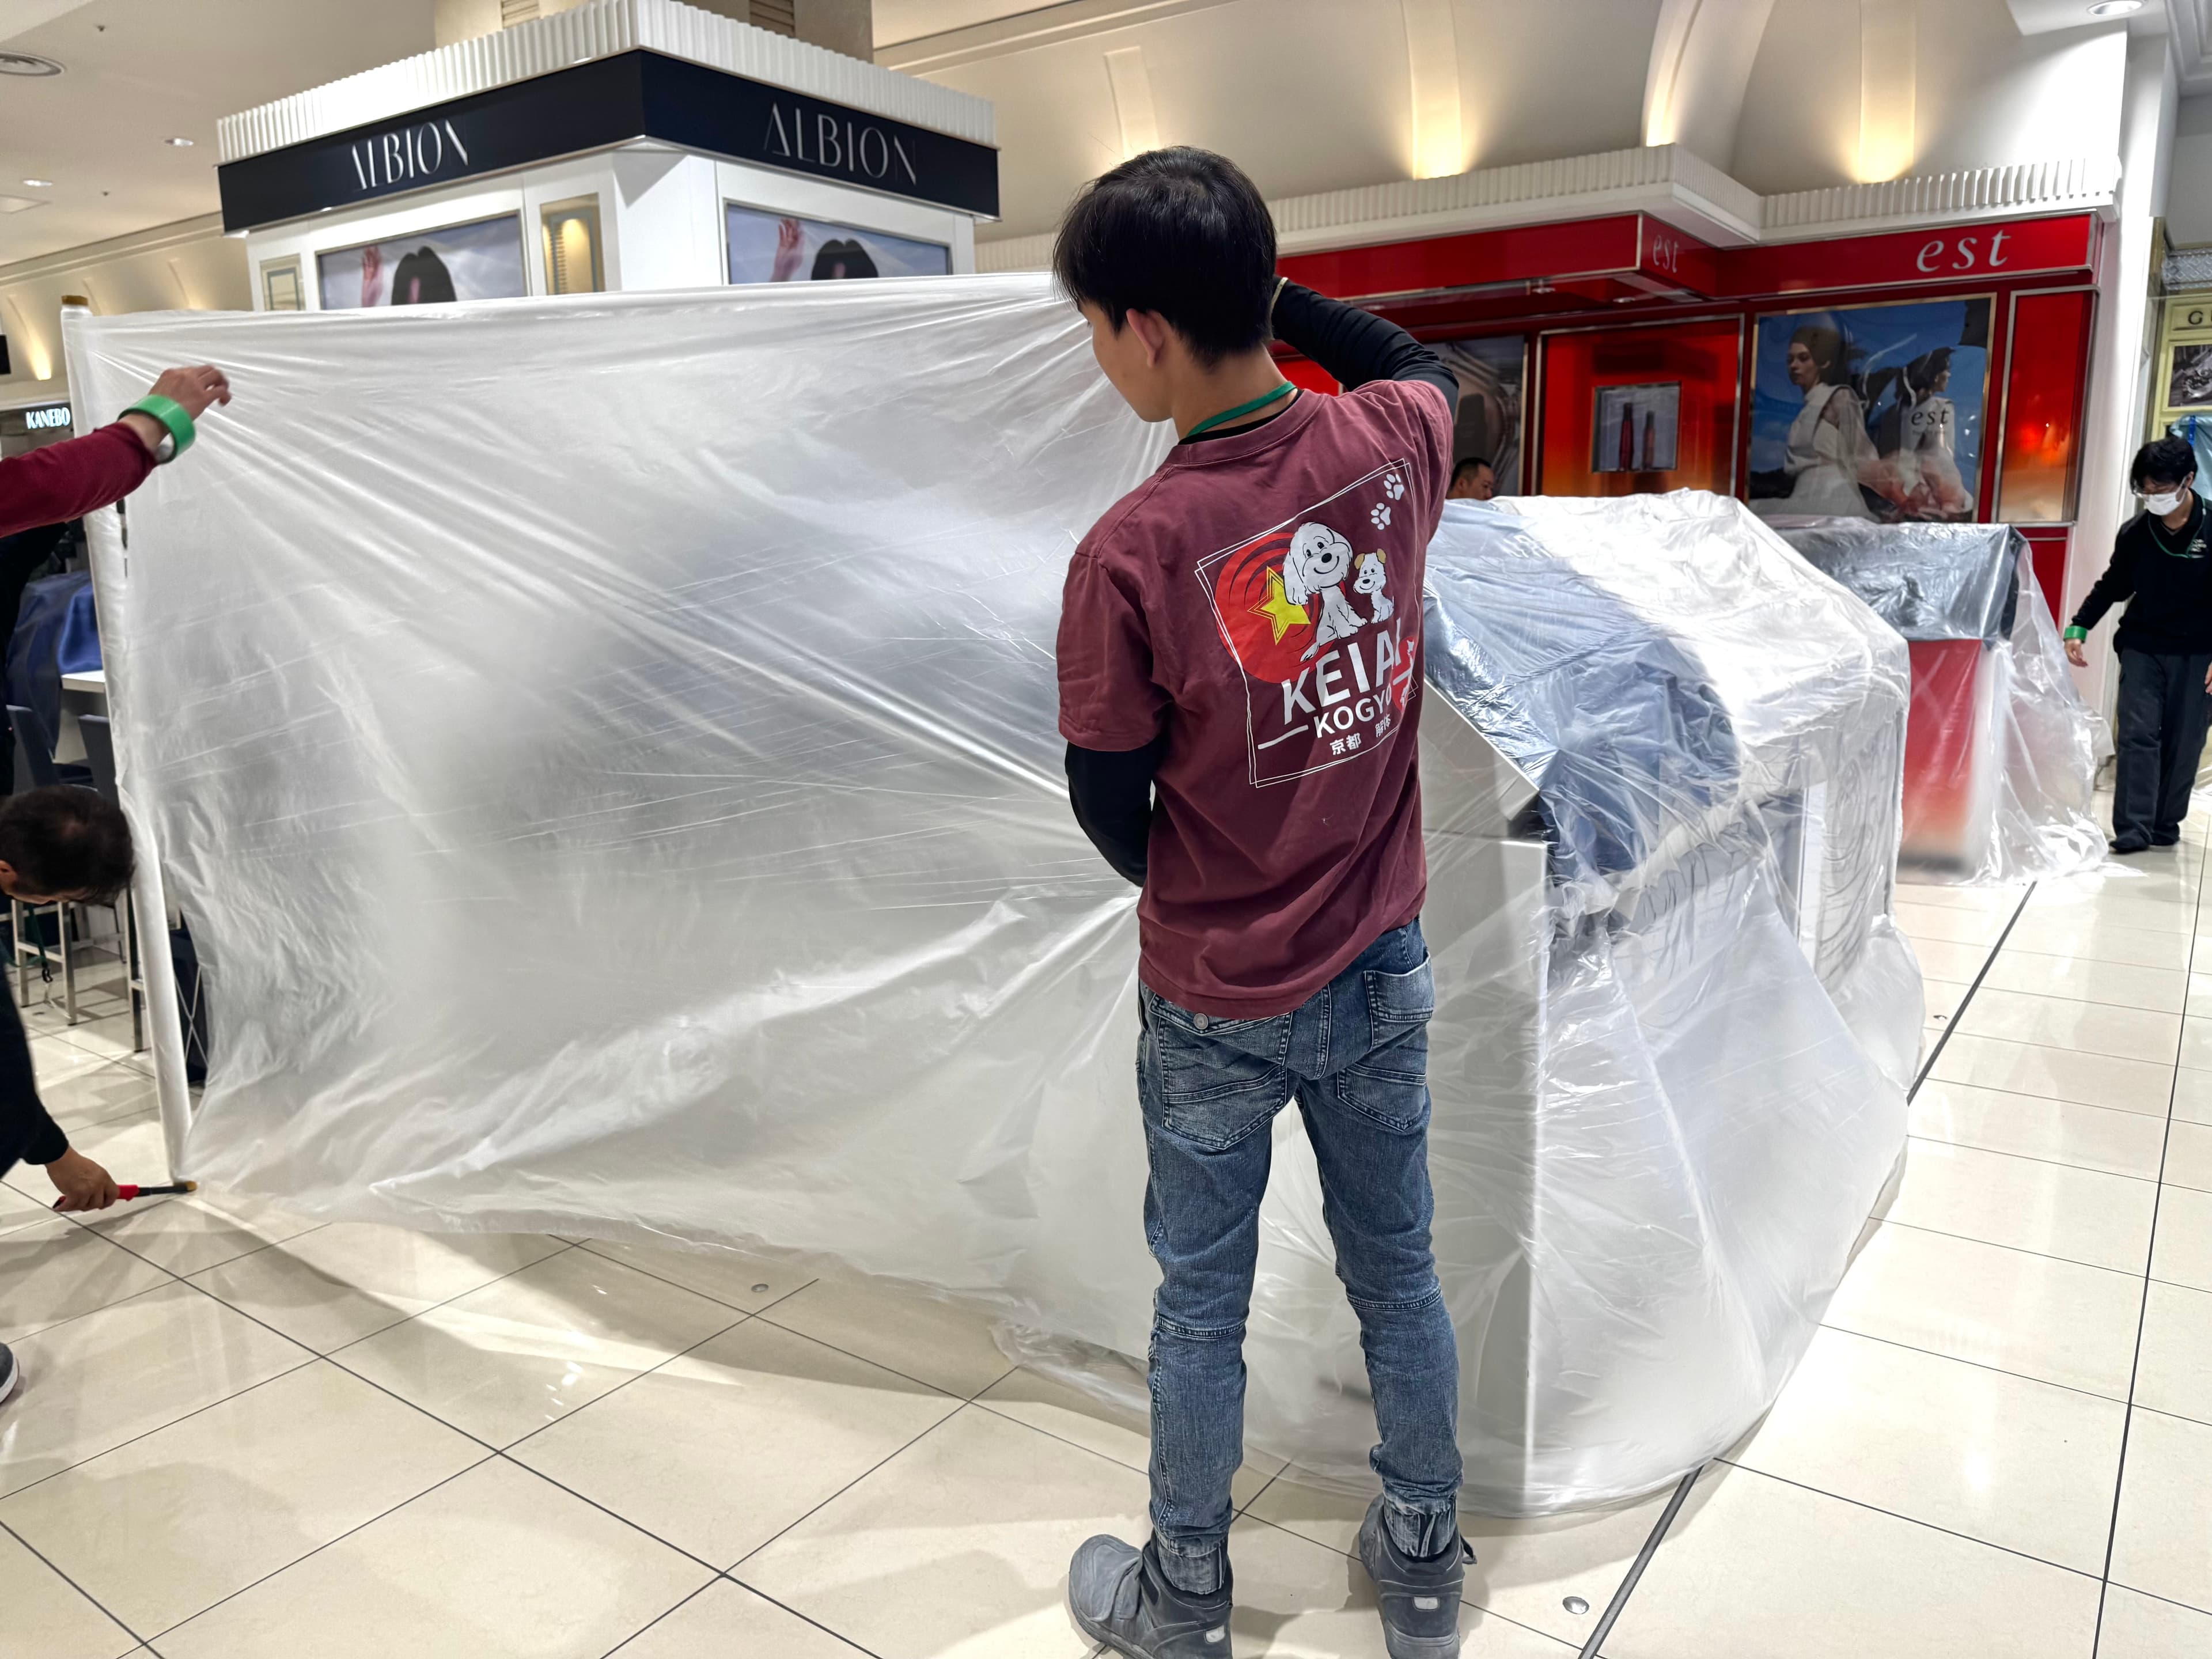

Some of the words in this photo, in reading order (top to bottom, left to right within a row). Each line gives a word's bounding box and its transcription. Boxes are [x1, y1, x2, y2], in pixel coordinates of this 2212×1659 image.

[350, 119, 469, 191] ALBION
[764, 103, 917, 185] ALBION
[1653, 234, 1680, 274] est
[1916, 229, 2012, 272] est
[2188, 309, 2212, 325] G
[25, 407, 71, 430] KANEBO
[1911, 408, 1949, 425] est
[1281, 618, 1402, 725] KEIAI
[1313, 683, 1392, 738] KOGYO
[1330, 732, 1362, 755] 京都
